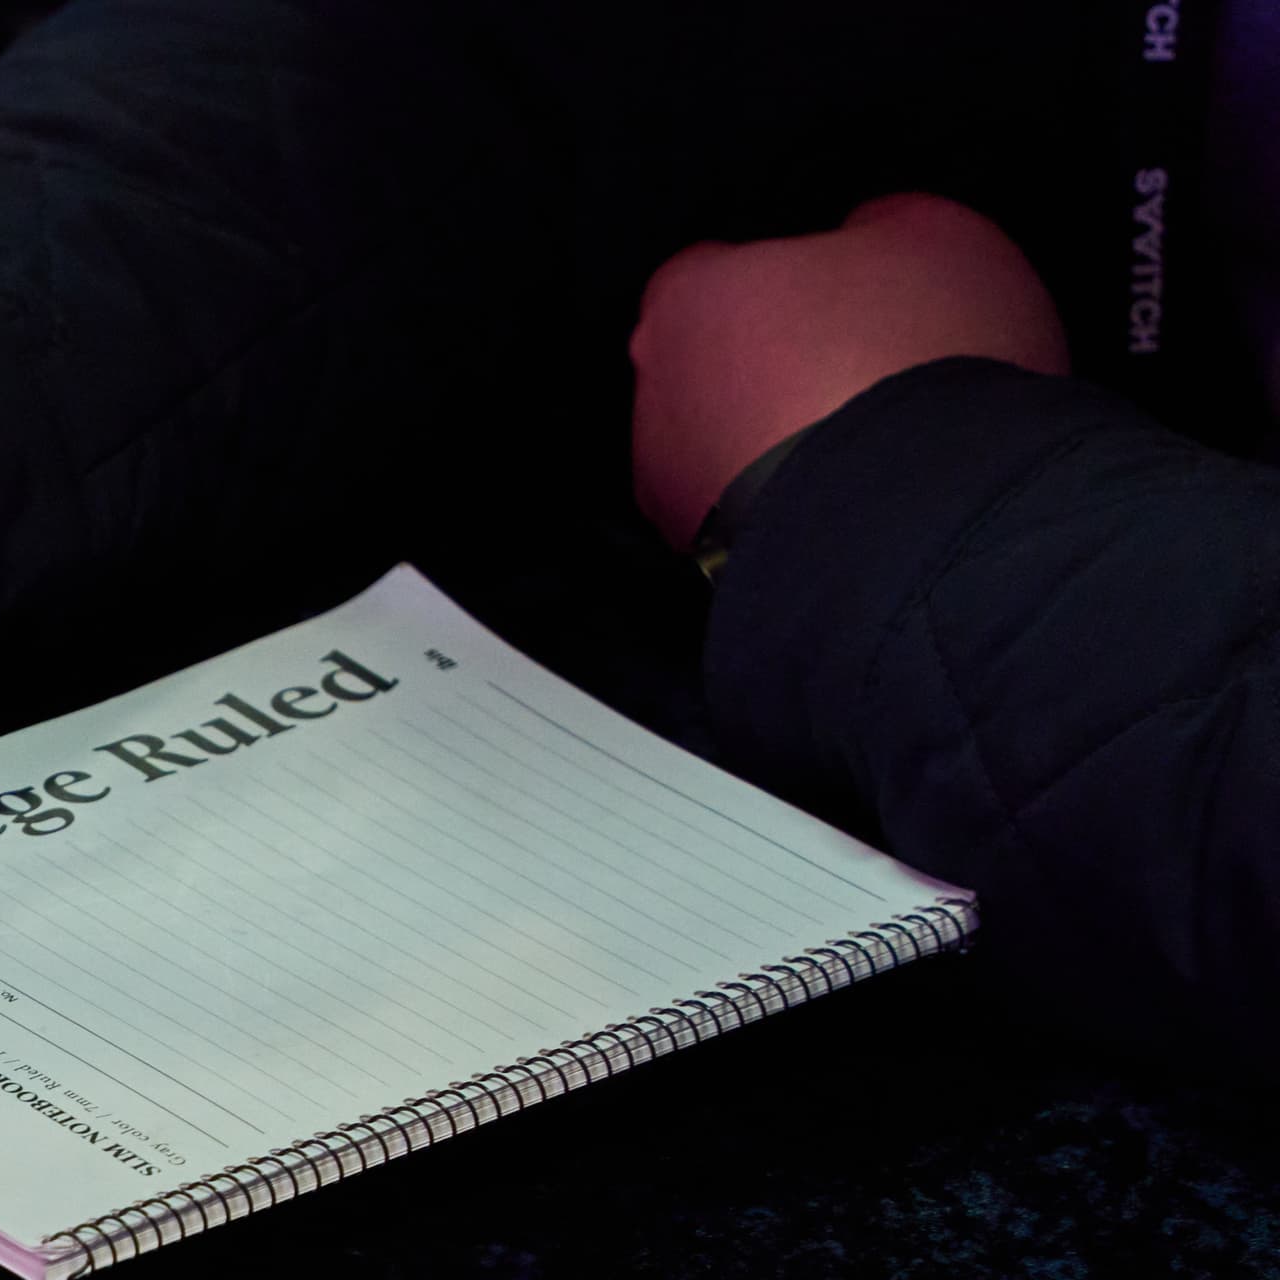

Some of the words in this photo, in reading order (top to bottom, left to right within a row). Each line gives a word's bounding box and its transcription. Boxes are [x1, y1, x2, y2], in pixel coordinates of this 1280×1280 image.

[93, 648, 400, 784] Ruled
[17, 1062, 62, 1092] Ruled
[111, 1117, 151, 1142] color
[101, 1142, 162, 1178] SLIM
[150, 1142, 187, 1168] Gray
